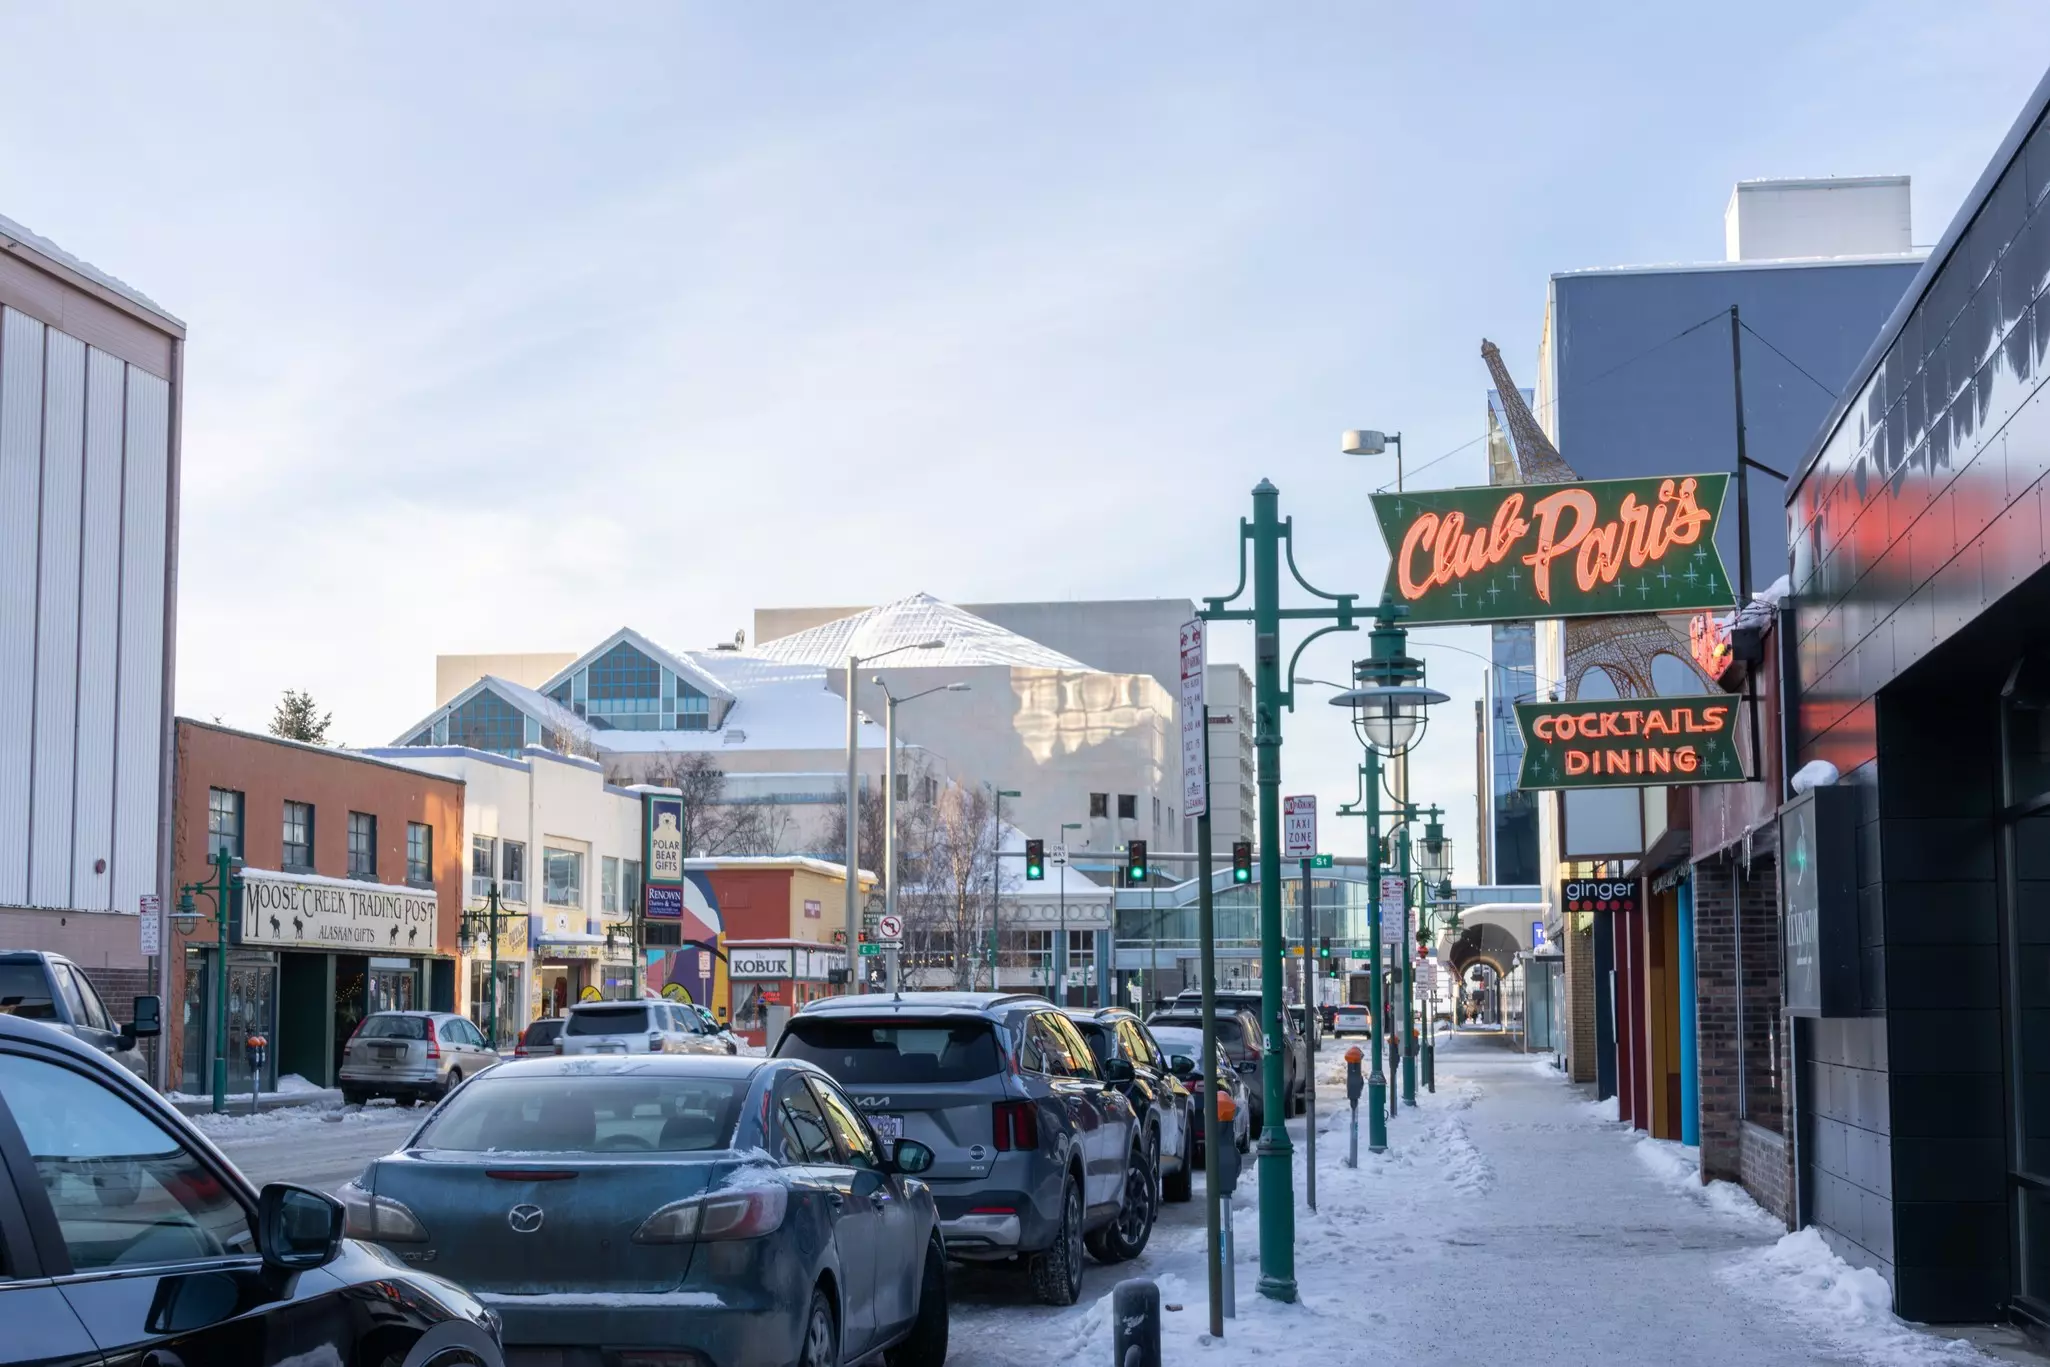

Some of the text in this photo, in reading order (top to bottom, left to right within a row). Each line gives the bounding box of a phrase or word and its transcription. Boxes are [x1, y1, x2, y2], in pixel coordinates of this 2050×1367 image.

[1398, 478, 1712, 605] Club Paris
[1532, 705, 1728, 743] COCKTAILS
[1565, 745, 1698, 776] DINING
[1285, 799, 1315, 813] NO PARKING
[1291, 819, 1311, 829] TAXI
[1289, 832, 1312, 843] ZONE
[653, 839, 679, 850] POLAR
[656, 850, 677, 861] BEAR
[1316, 858, 1327, 866] St
[655, 861, 677, 871] GIFTS
[649, 888, 681, 900] RENOWN
[1566, 880, 1635, 900] ginger
[245, 884, 299, 938] MOOSE
[302, 888, 347, 918] CREEK
[350, 892, 402, 921] TRADING
[404, 898, 436, 948] POST
[318, 926, 374, 943] ALASKAN GIFTS
[734, 960, 788, 973] KOBUK
